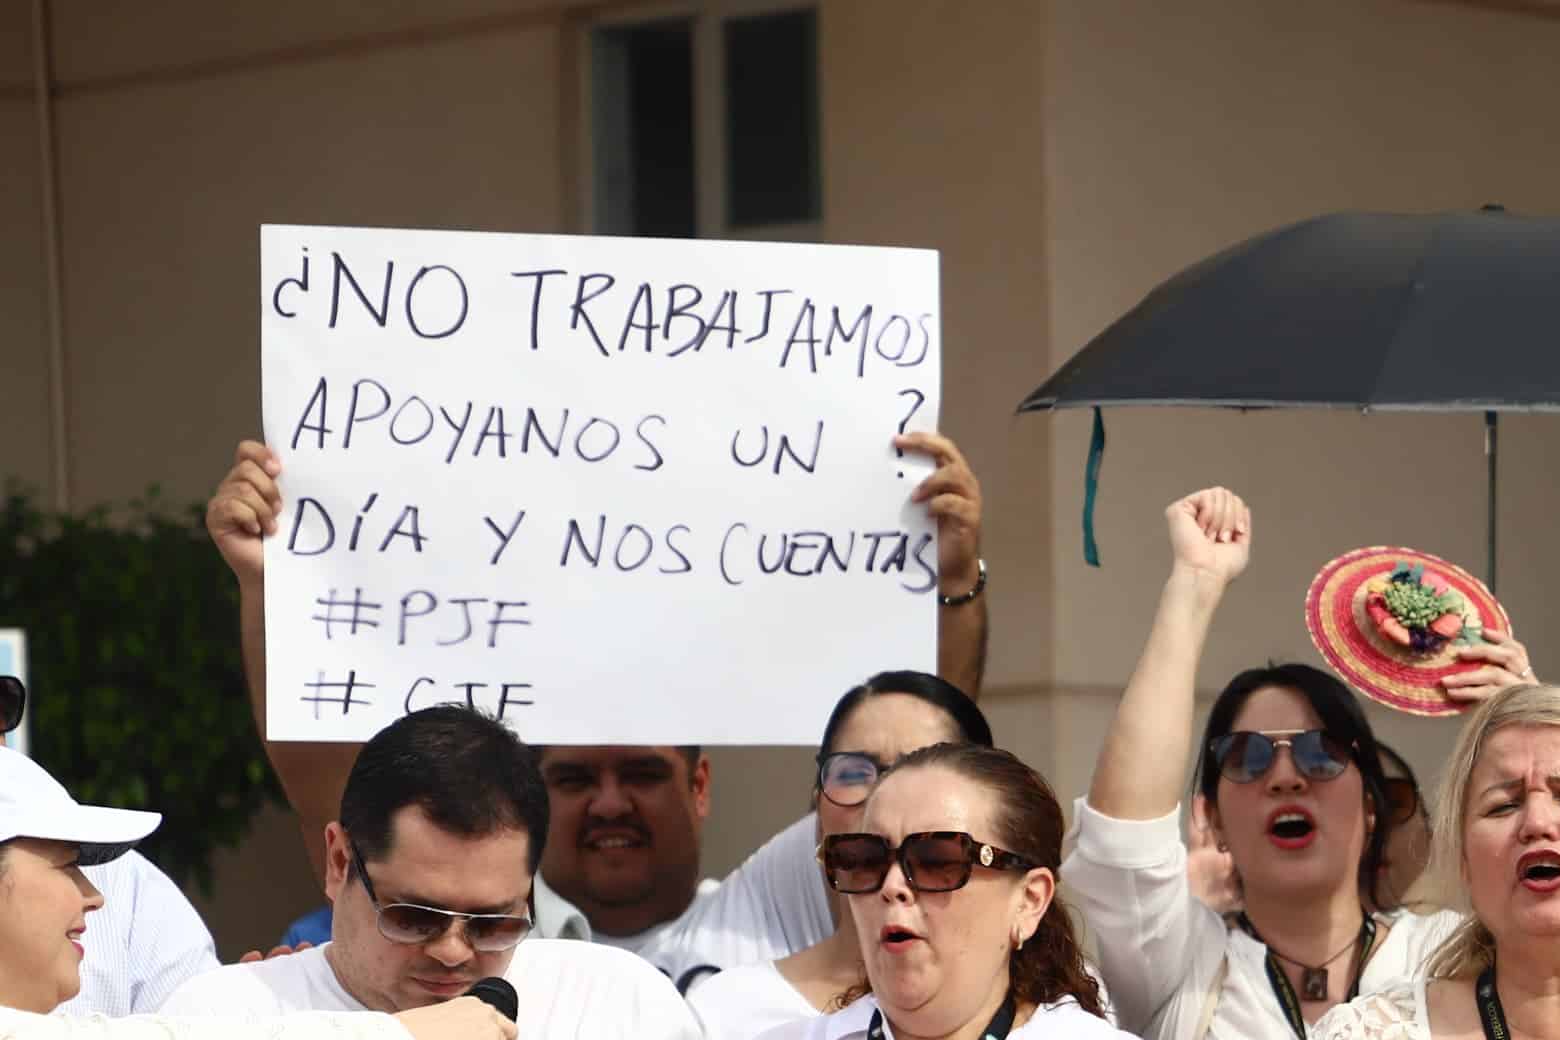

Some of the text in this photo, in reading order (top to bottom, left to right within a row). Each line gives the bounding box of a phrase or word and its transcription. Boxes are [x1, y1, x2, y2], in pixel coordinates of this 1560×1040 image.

[273, 246, 928, 378] ¿NO TRABAJAMOS
[291, 376, 666, 472] APOYANOS
[731, 420, 824, 475] UN
[287, 492, 935, 594] DÍA Y NOS CUENTAS
[312, 587, 531, 648] #PJF
